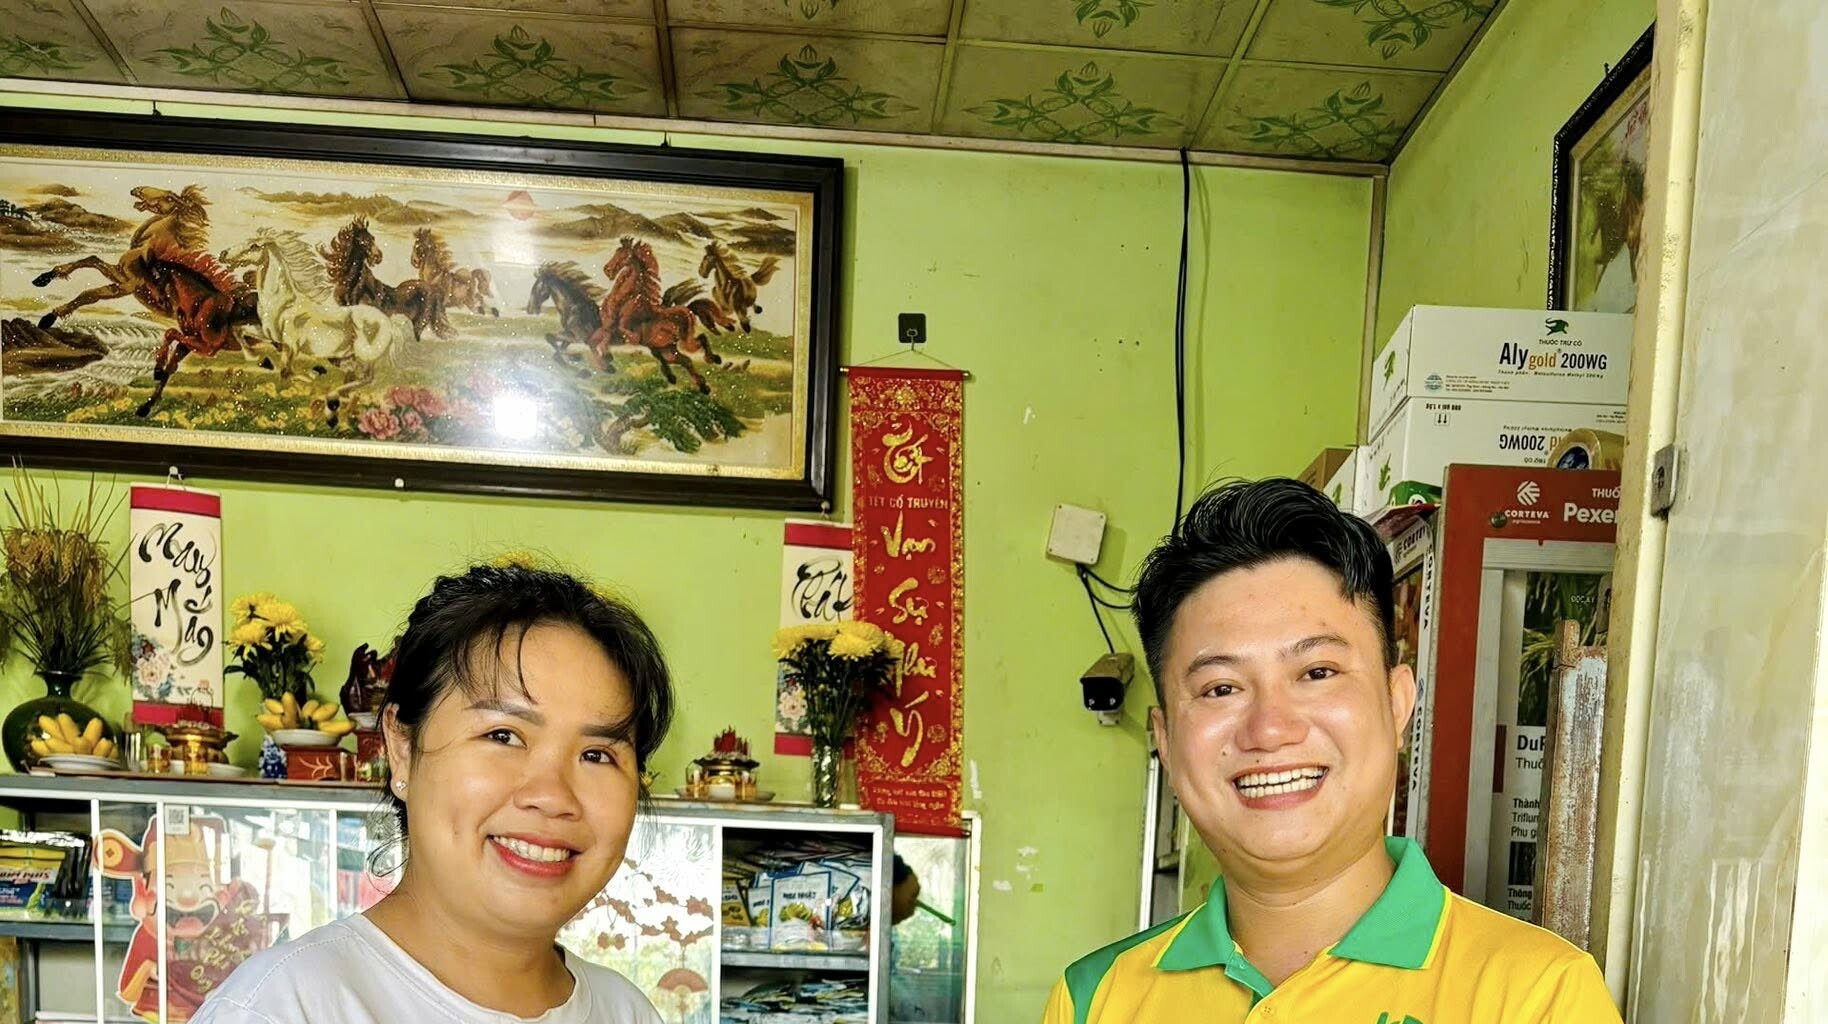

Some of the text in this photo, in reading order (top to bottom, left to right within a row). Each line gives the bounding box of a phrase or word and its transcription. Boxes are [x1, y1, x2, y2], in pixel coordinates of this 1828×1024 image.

[1560, 352, 1608, 370] 200WG
[1499, 434, 1546, 451] 200WG
[1592, 486, 1621, 498] THUỐ
[1504, 510, 1550, 519] CORTEVA
